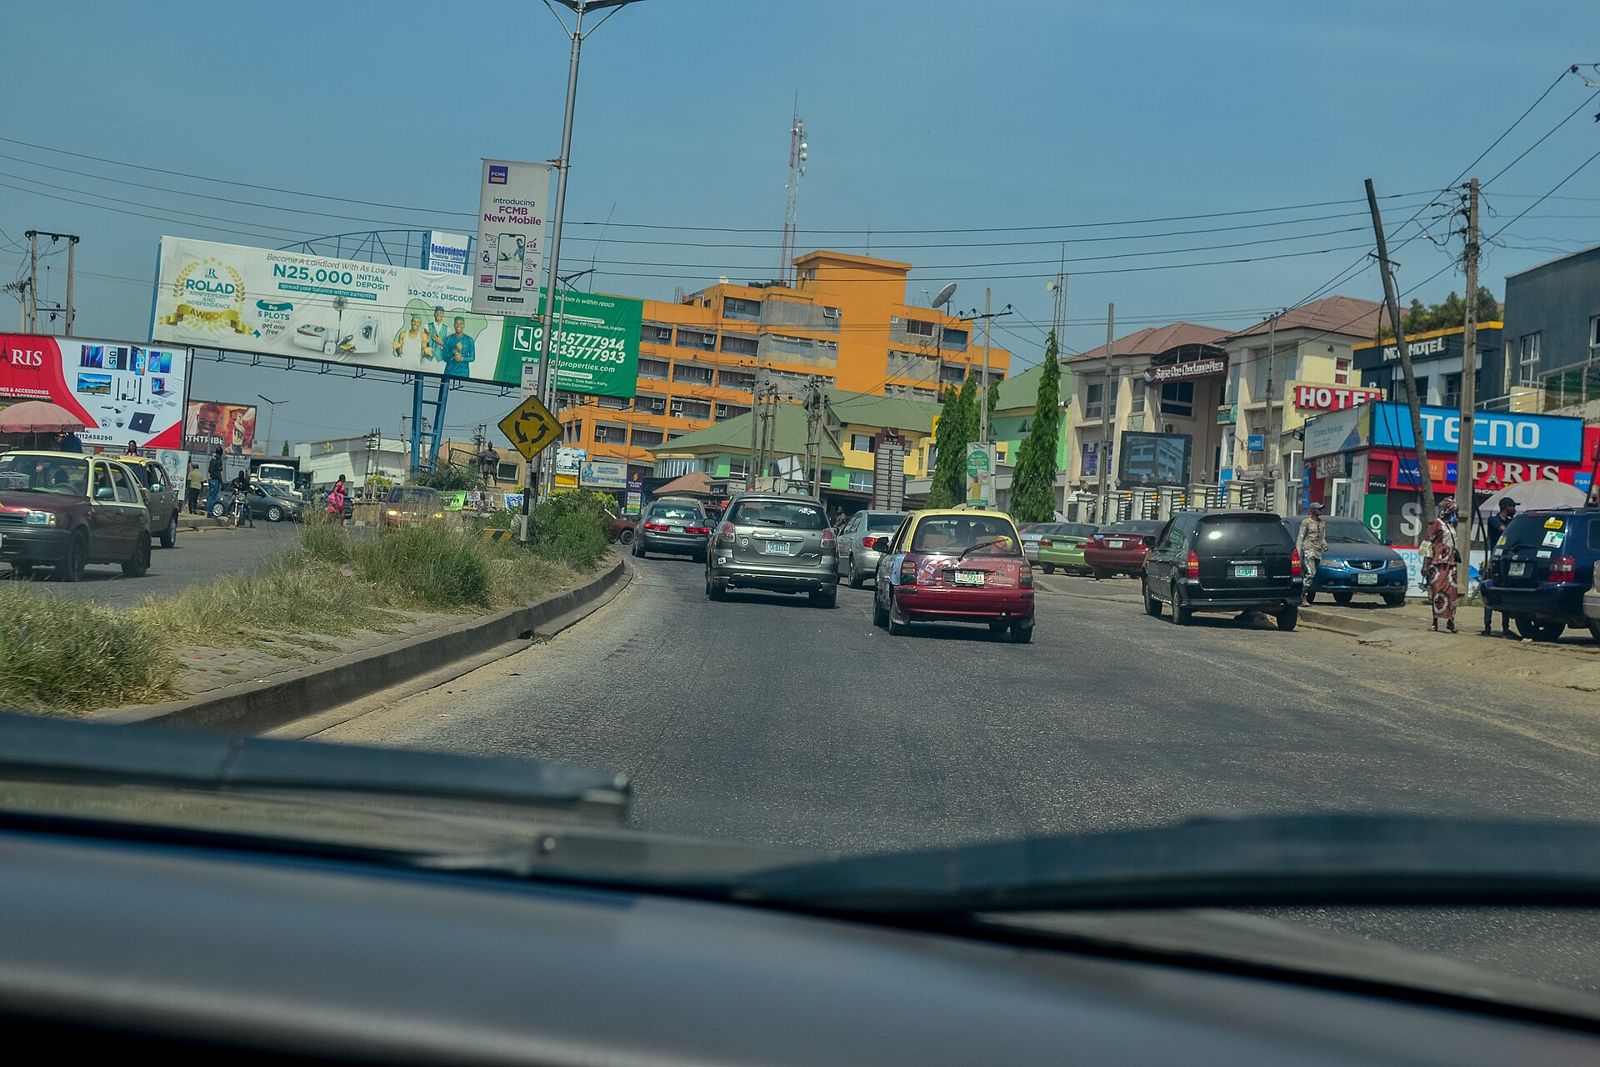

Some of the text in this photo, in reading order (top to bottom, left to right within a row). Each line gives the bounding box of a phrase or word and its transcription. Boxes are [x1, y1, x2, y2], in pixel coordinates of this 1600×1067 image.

[493, 197, 536, 208] introducing
[499, 206, 528, 216] FCMB
[484, 214, 542, 228] New Mobile
[267, 254, 298, 264] Become
[306, 259, 340, 269] Landlord
[341, 263, 359, 272] With
[360, 266, 370, 274] As
[371, 267, 387, 277] Low
[387, 269, 398, 278] As
[273, 264, 384, 286] N25,000 INITIAL
[186, 279, 235, 294] ROLAD
[356, 281, 390, 291] DEPOSIT
[408, 289, 439, 299] 10-20%
[186, 301, 231, 309] INDEPENDENCE
[264, 312, 290, 320] PLOTS
[534, 328, 625, 351] 0115777914
[1409, 337, 1446, 357] HOTEL
[108, 350, 117, 367] S10
[534, 340, 626, 364] 0115777913
[1300, 387, 1375, 409] HOTE
[1420, 414, 1540, 449] TECNO
